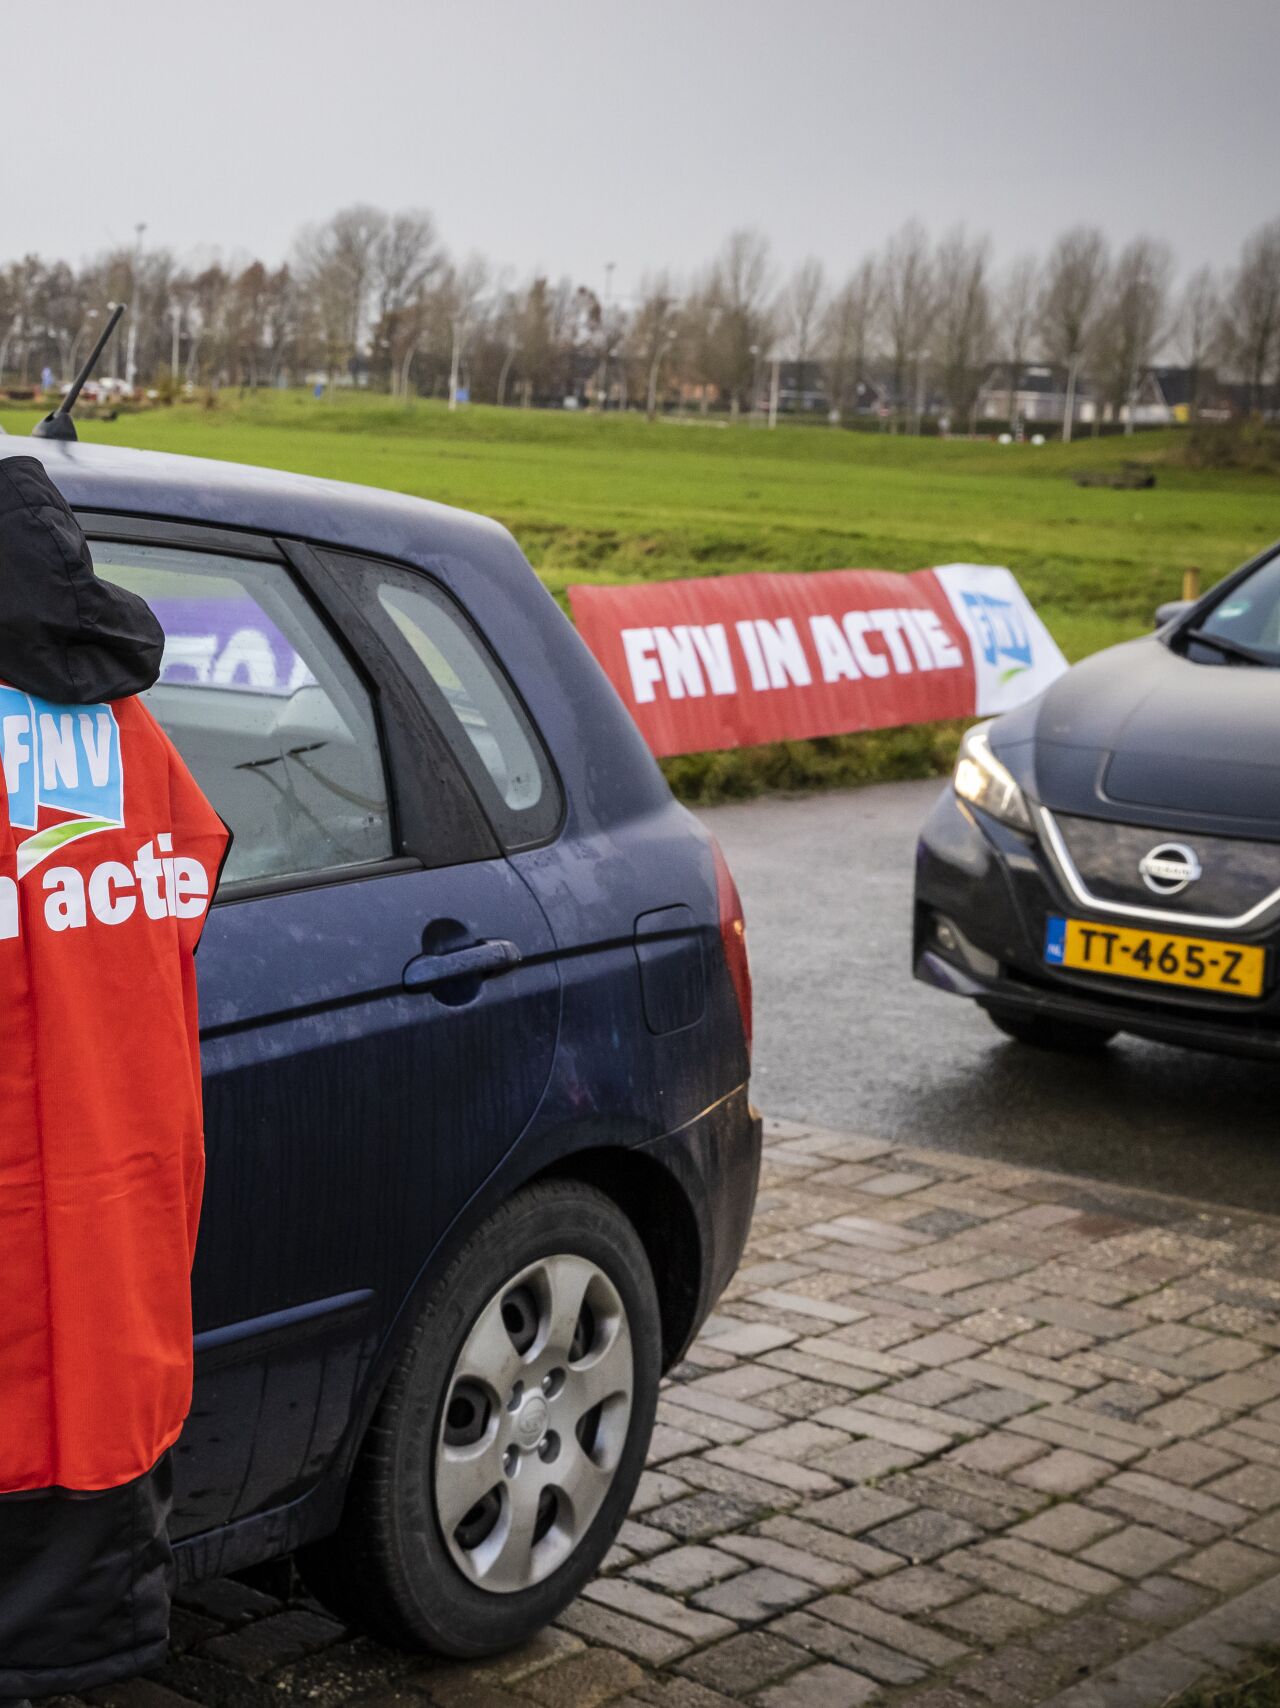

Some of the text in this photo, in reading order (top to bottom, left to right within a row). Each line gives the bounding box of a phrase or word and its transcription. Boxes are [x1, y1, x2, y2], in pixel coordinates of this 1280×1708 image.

[621, 608, 963, 704] FNV IN ACTIE
[3, 712, 113, 793] FNV
[43, 833, 209, 931] actie
[1079, 929, 1243, 985] TT-465-Z
